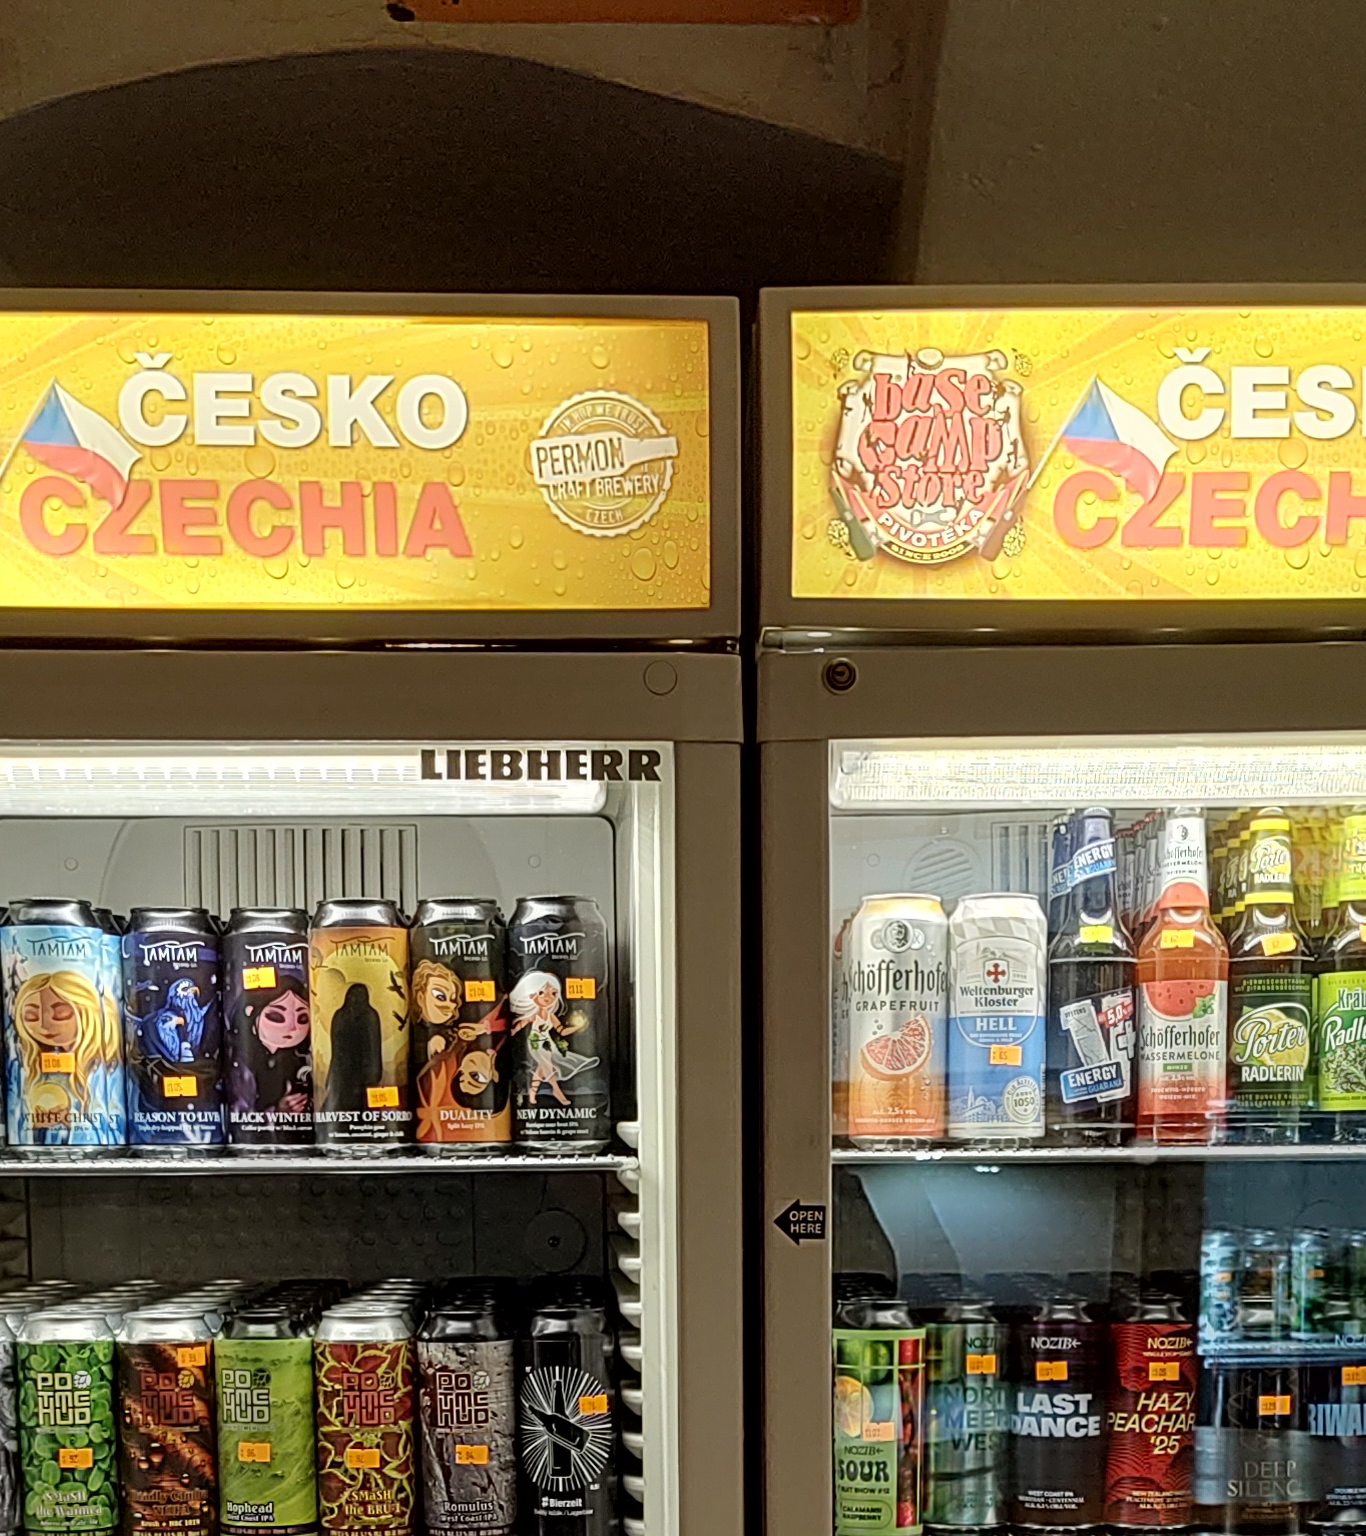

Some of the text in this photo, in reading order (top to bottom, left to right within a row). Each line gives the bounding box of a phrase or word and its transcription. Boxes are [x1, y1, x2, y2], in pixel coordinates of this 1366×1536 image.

[118, 351, 469, 449] ČESKO
[536, 437, 625, 479] PERMON
[550, 474, 660, 500] CRAFT BREWERY
[19, 479, 474, 558] CZECHIA
[586, 508, 623, 523] CZECH
[878, 510, 985, 547] PIVOTÉKA
[421, 749, 661, 781] LIEBHERR
[1073, 844, 1114, 868] ENERGY
[139, 941, 207, 963] TAMTAM
[429, 935, 495, 957] TAMTAM
[520, 933, 586, 956] TAMTAM
[959, 984, 1035, 999] Weltenburger
[855, 999, 940, 1013] GRAPEFRUIT
[974, 995, 1019, 1009] Kloster
[975, 1017, 1018, 1031] HELL
[1140, 1024, 1221, 1051] Schöfferhofer
[1236, 1013, 1308, 1063] Porter
[1067, 1064, 1118, 1087] ENERGY
[1241, 1066, 1304, 1083] RADLERIN
[134, 1111, 180, 1123] REASON
[182, 1112, 197, 1123] TO
[230, 1112, 312, 1124] BLACK WINTER
[362, 1112, 375, 1123] OF
[439, 1109, 494, 1121] DUALITY
[516, 1108, 597, 1120] NEW DYNAMIC
[789, 1210, 823, 1222] OPEN
[790, 1223, 822, 1234] HERE
[1017, 1392, 1092, 1414] LAST
[1136, 1391, 1195, 1412] HAZY
[1011, 1414, 1101, 1438] DANCE
[227, 1501, 274, 1516] Hophead
[444, 1501, 494, 1512] Romulus
[549, 1498, 583, 1509] Bierzeit
